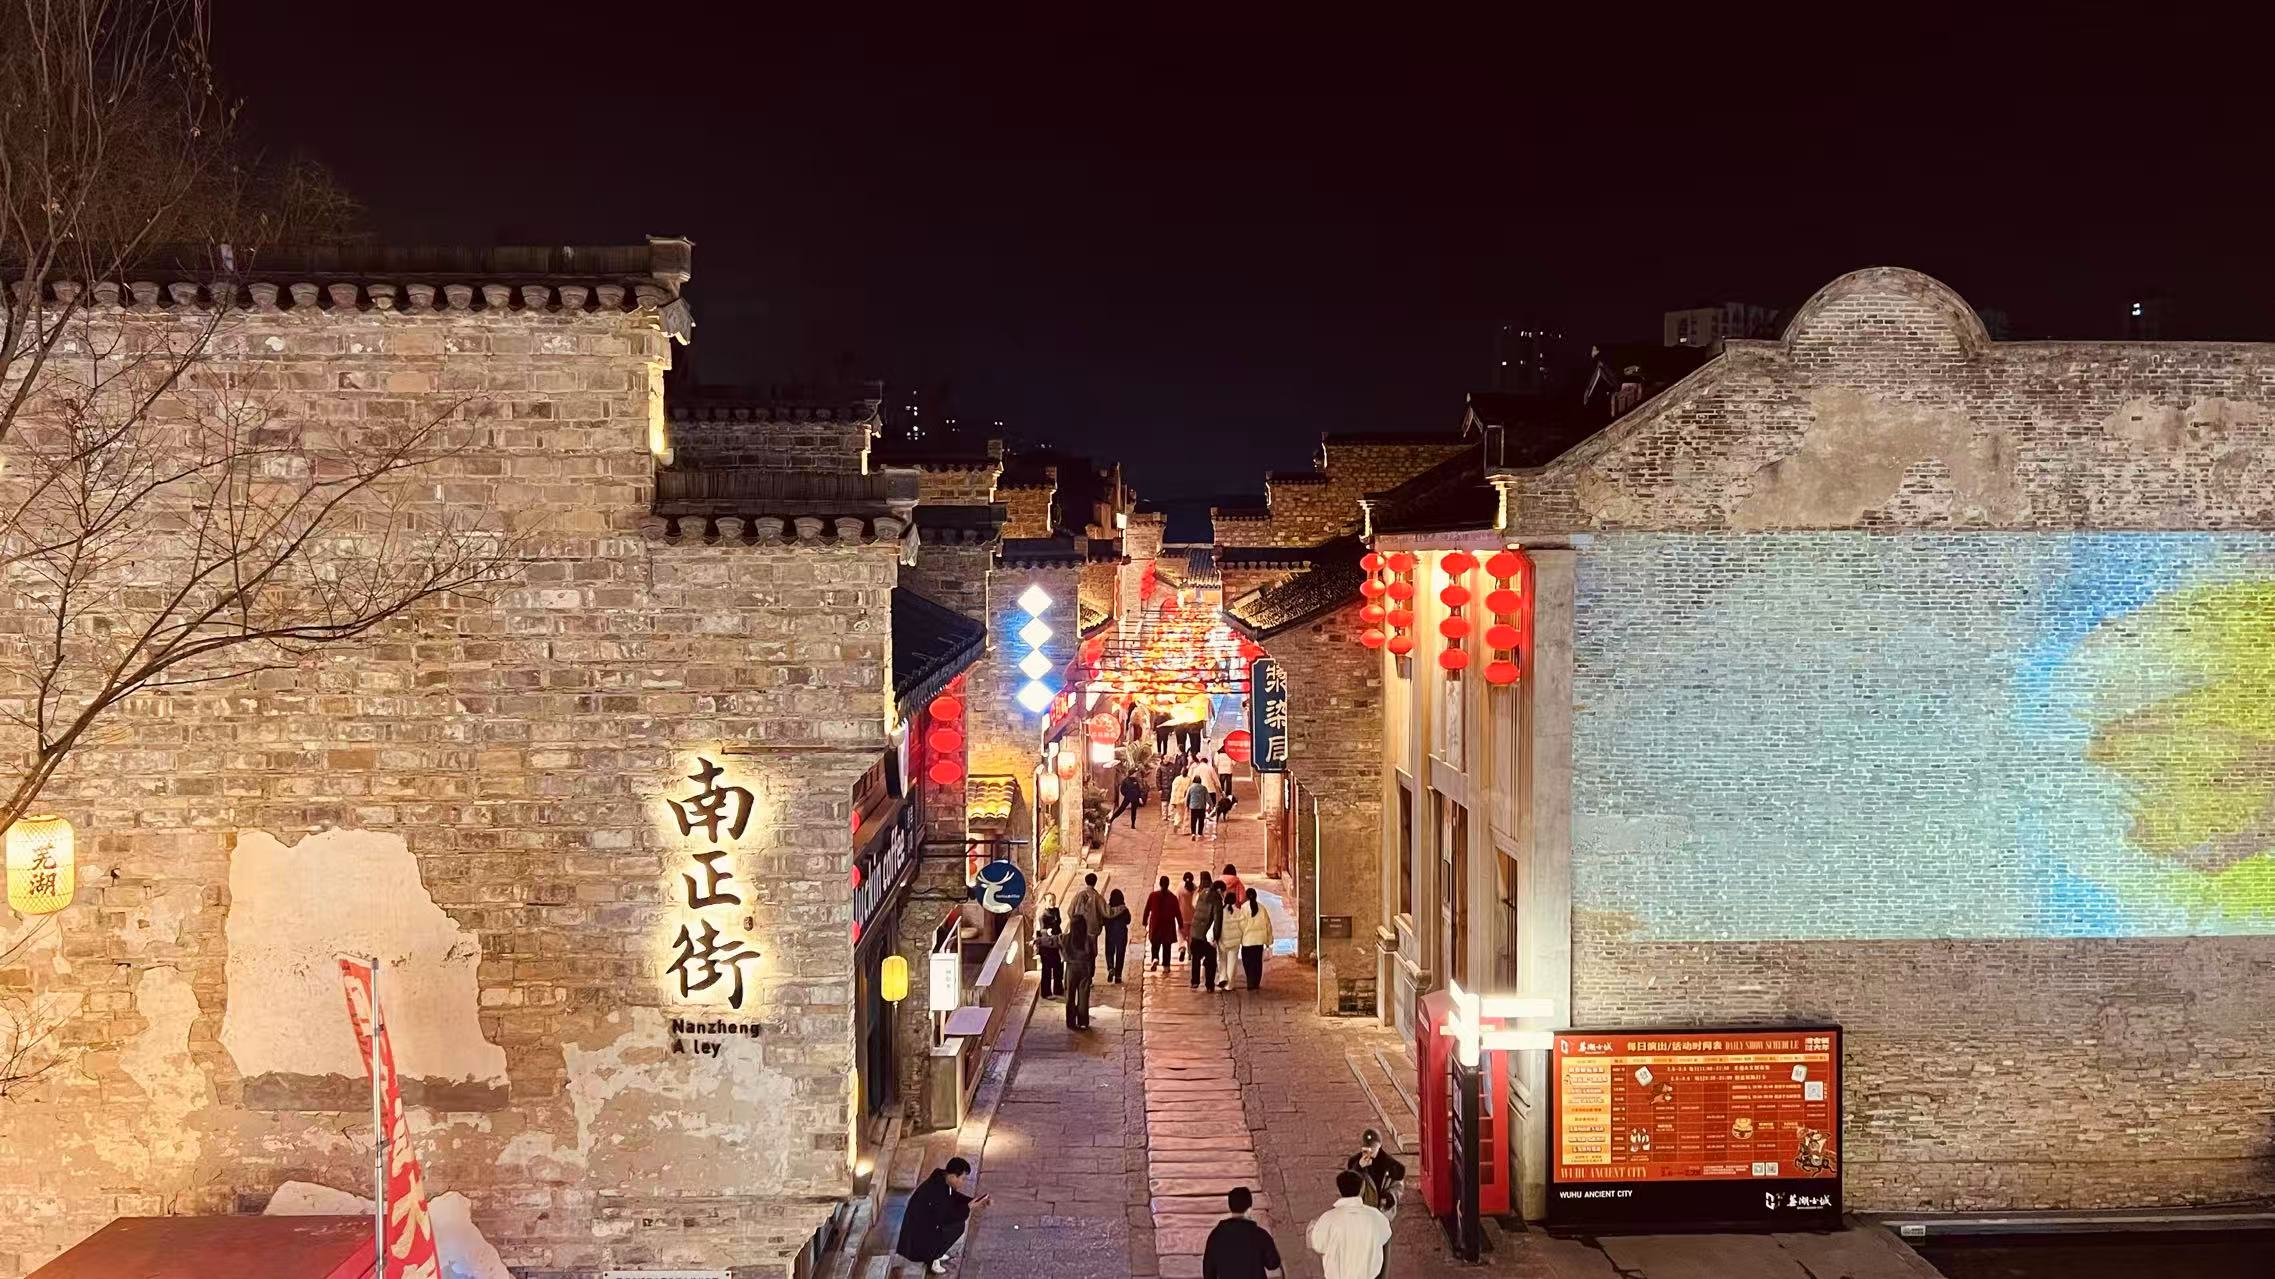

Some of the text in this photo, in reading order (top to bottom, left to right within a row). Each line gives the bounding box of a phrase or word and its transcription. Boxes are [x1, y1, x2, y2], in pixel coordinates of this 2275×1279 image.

[883, 825, 905, 891] coffee
[29, 841, 57, 897] 芜湖
[667, 757, 761, 1009] 南正街
[672, 1019, 760, 1038] Nanzheng
[1627, 1041, 1722, 1052] 每日演出/活动时间表
[1725, 1040, 1743, 1050] DAILY
[1745, 1040, 1763, 1050] SHOW
[1766, 1039, 1799, 1050] SCHEDULE
[1561, 1167, 1585, 1178] WUHU
[1590, 1167, 1625, 1178] ANCIENT
[1627, 1167, 1647, 1178] CITY
[1584, 1190, 1615, 1198] ANCIENT
